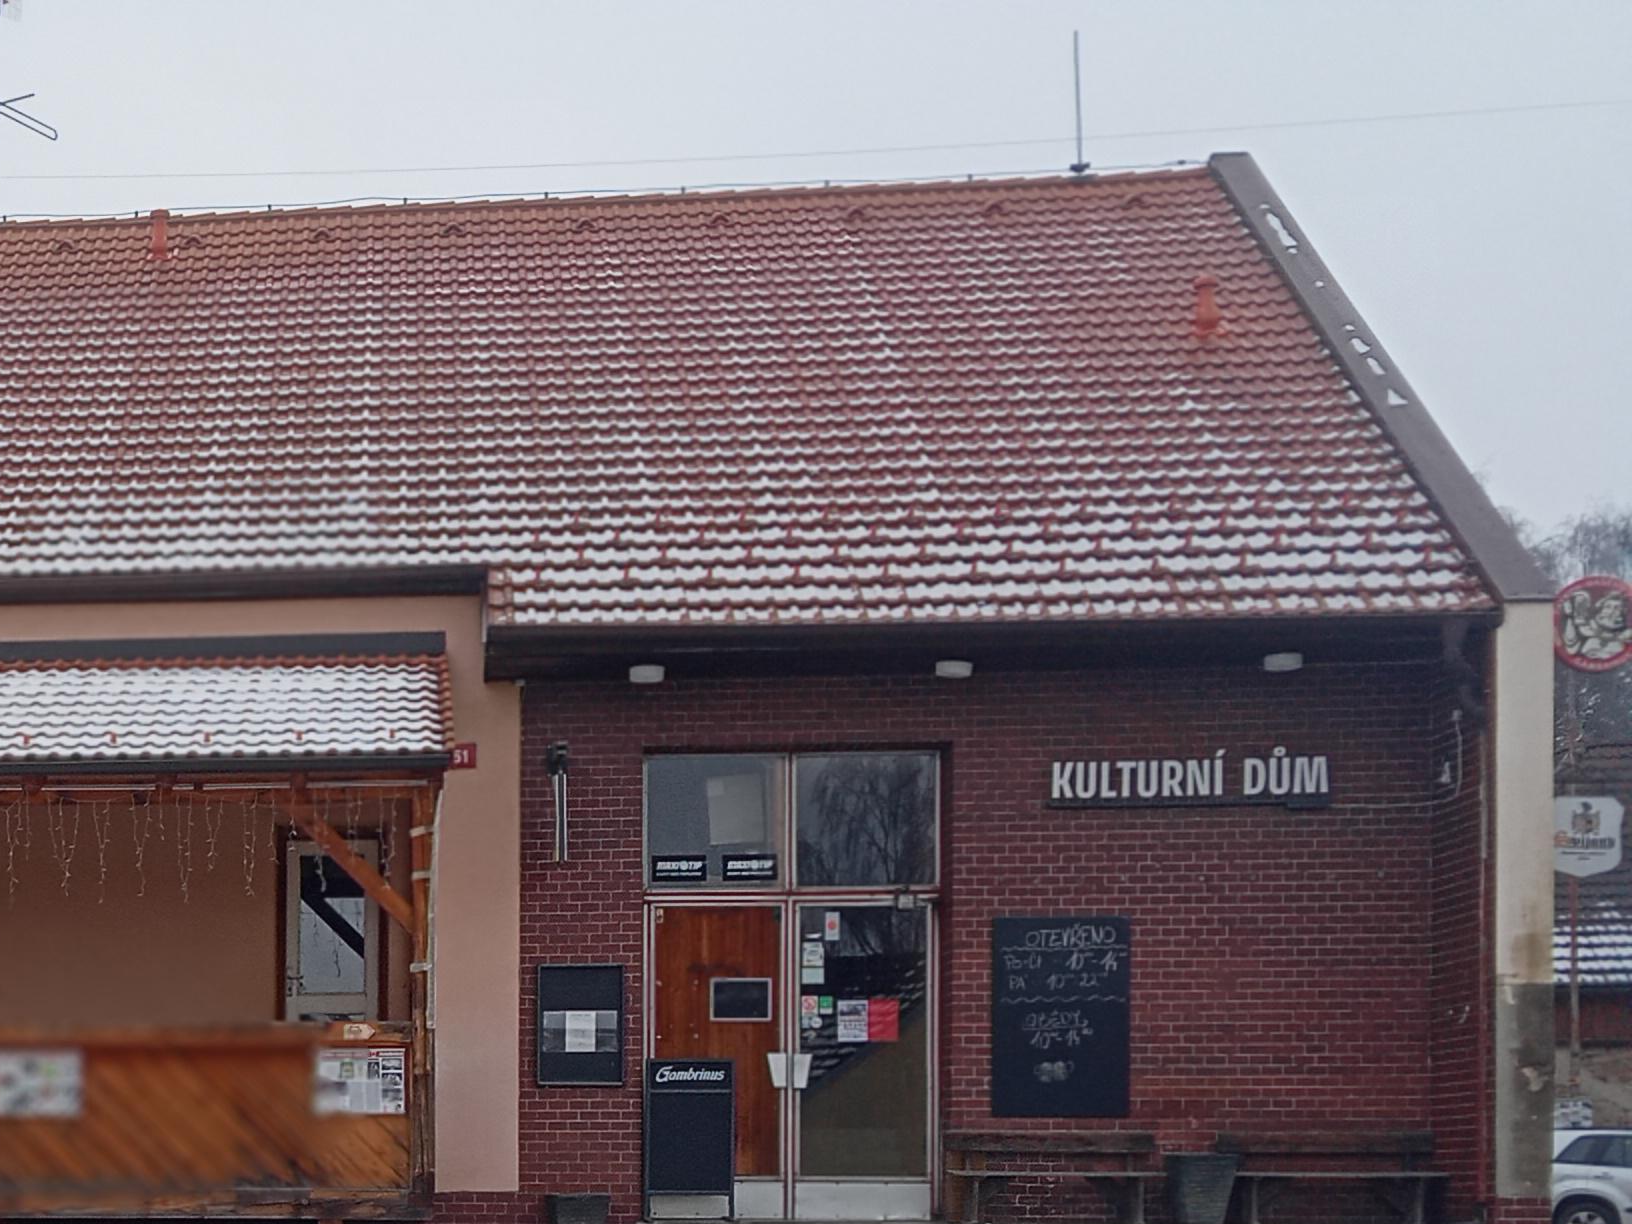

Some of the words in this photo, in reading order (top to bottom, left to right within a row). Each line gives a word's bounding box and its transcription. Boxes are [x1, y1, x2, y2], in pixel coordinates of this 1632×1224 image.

[1051, 749, 1226, 799] KULTURNÍ
[1243, 746, 1329, 796] DŮM
[655, 1065, 726, 1083] Gambrinus
